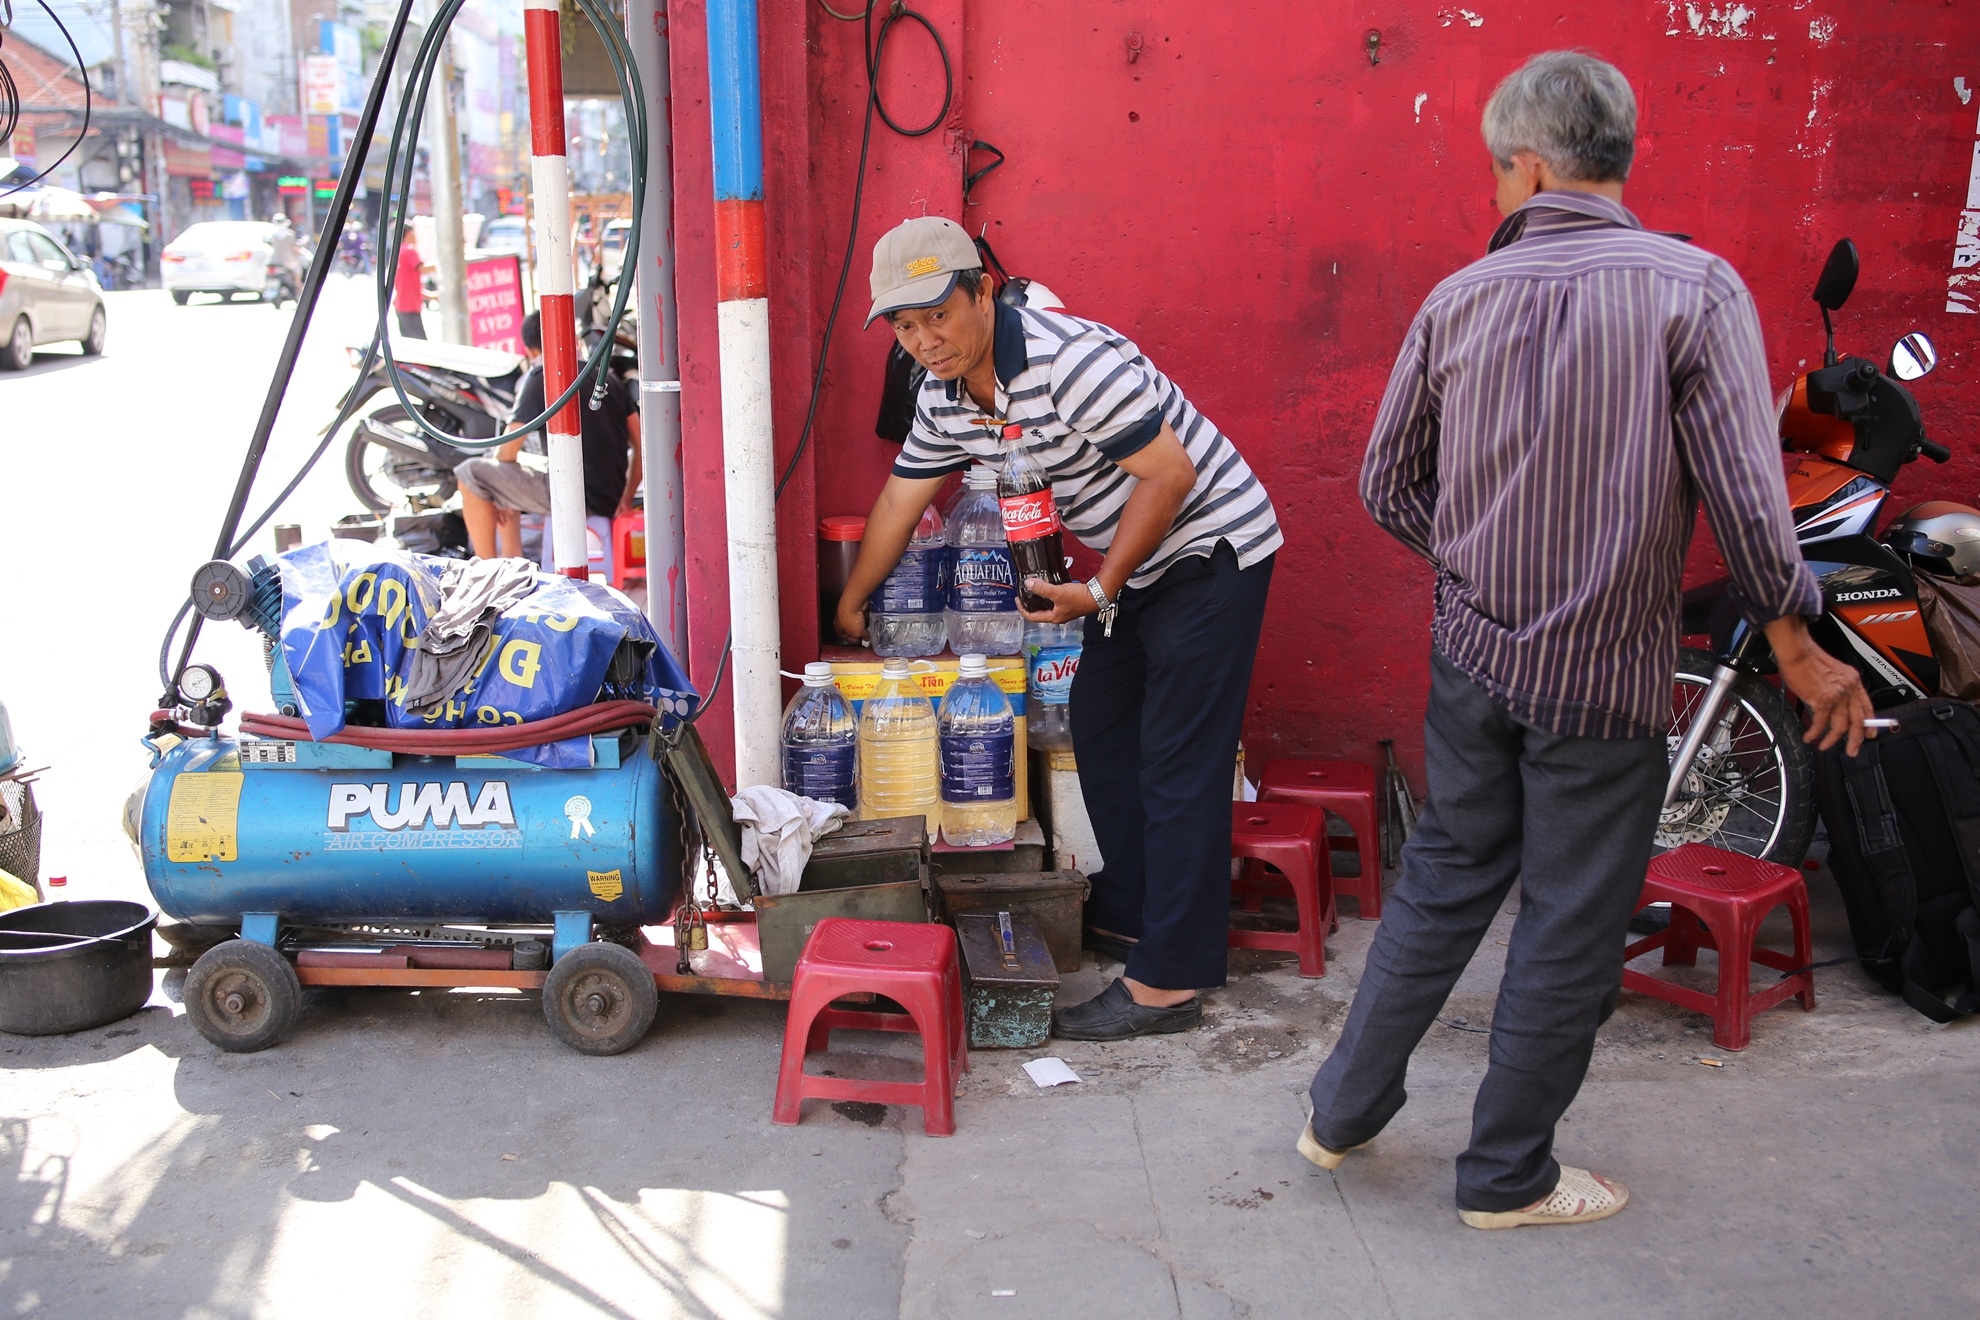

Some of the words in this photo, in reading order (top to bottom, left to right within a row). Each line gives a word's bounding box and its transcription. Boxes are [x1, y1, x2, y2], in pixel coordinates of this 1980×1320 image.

[906, 255, 939, 271] adidas
[954, 560, 1014, 587] AQUAFINA
[1836, 588, 1902, 602] HONDA
[327, 781, 520, 832] PUMA
[329, 834, 365, 849] AIR
[370, 831, 521, 850] COMPRESSOR
[590, 874, 620, 882] WARNING
